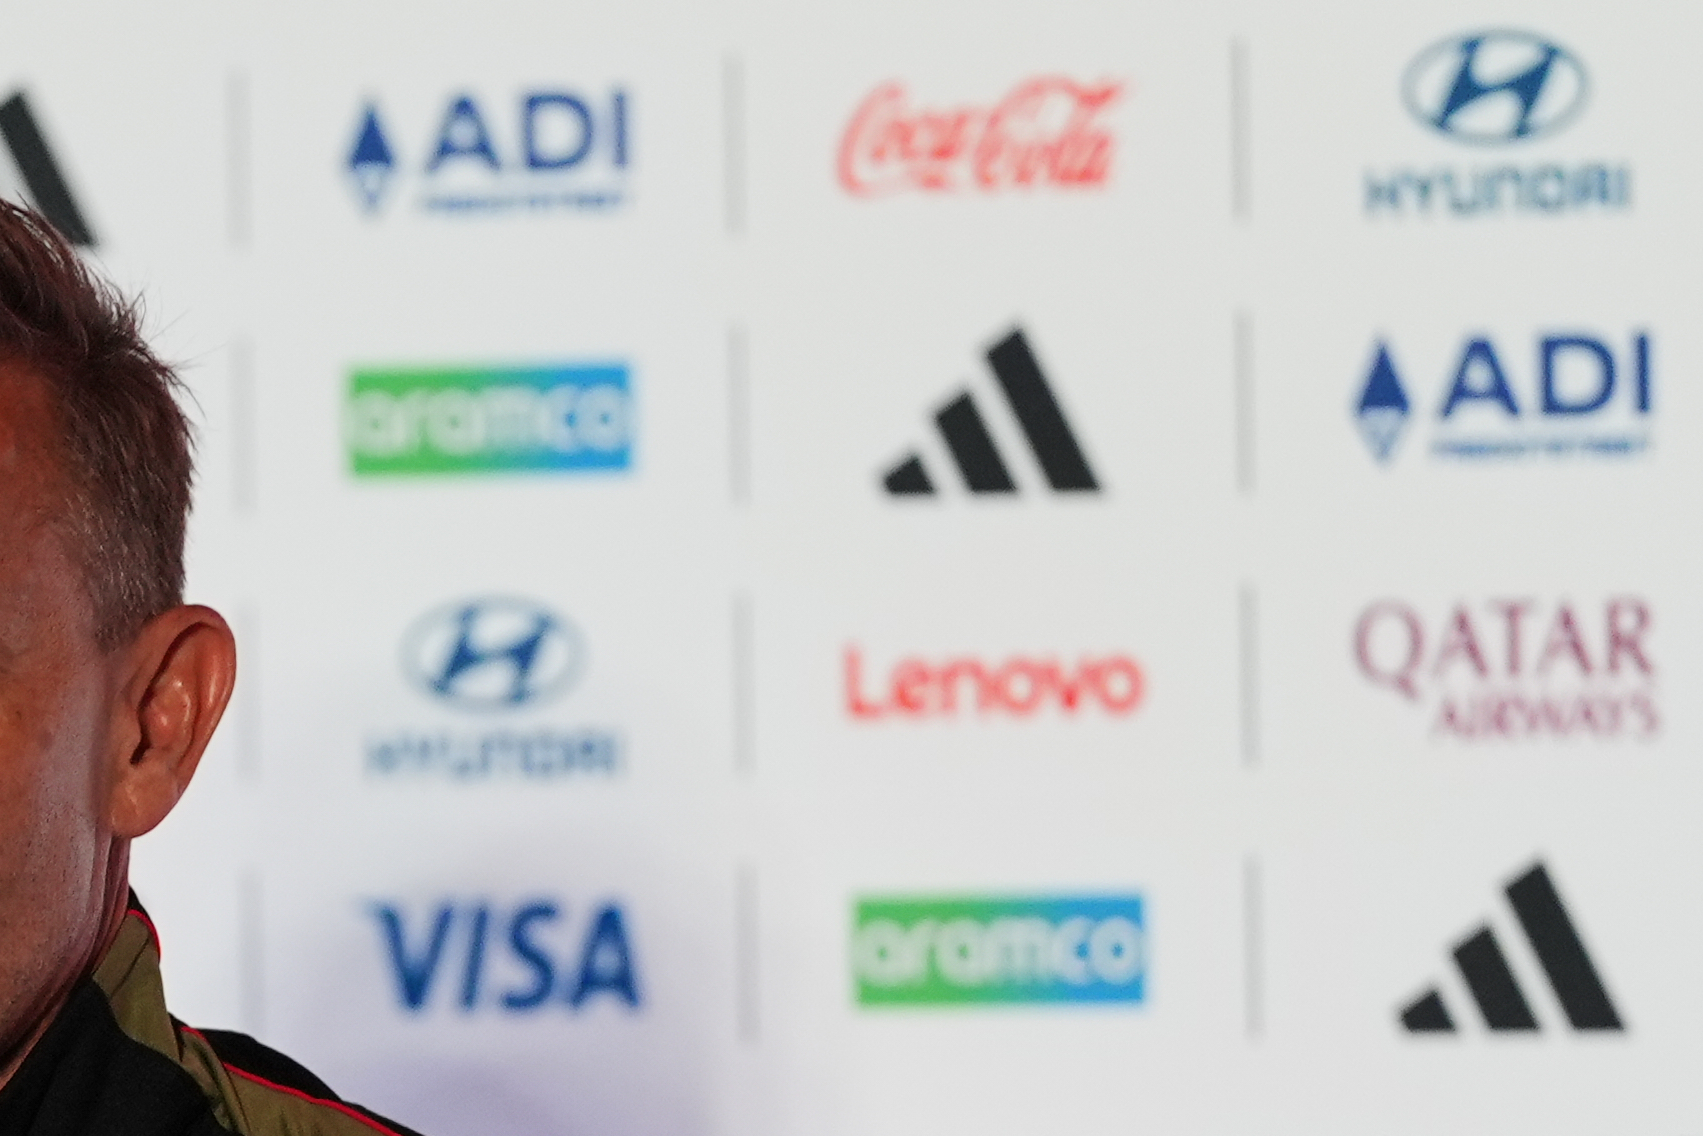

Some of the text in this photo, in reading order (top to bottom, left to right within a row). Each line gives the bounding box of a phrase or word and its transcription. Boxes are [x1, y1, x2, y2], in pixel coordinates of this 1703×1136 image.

[424, 90, 630, 172] ADI
[1438, 330, 1653, 418] ADI
[348, 384, 632, 456] aramco
[845, 648, 1145, 721] Lenovo
[1352, 598, 1658, 702] QATAR
[1433, 691, 1662, 742] AIRWAYS
[373, 898, 644, 1016] VISA
[858, 912, 1146, 986] aramco
